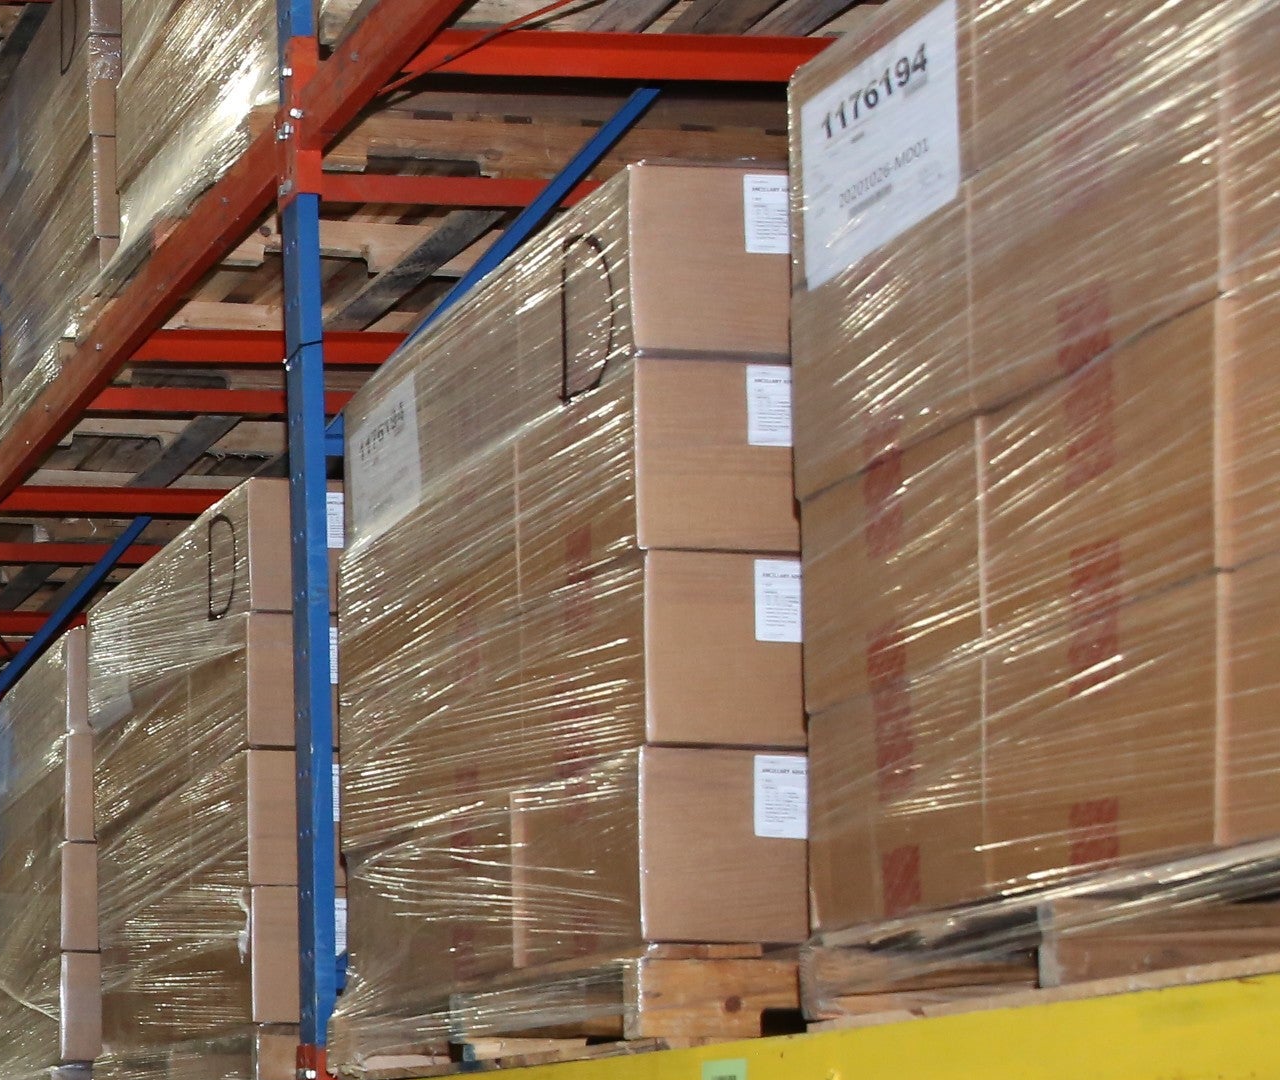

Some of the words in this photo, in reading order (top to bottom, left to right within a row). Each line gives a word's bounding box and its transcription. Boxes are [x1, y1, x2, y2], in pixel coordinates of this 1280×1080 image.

[821, 42, 928, 139] 1176194
[561, 233, 614, 404] D
[206, 514, 236, 622] D
